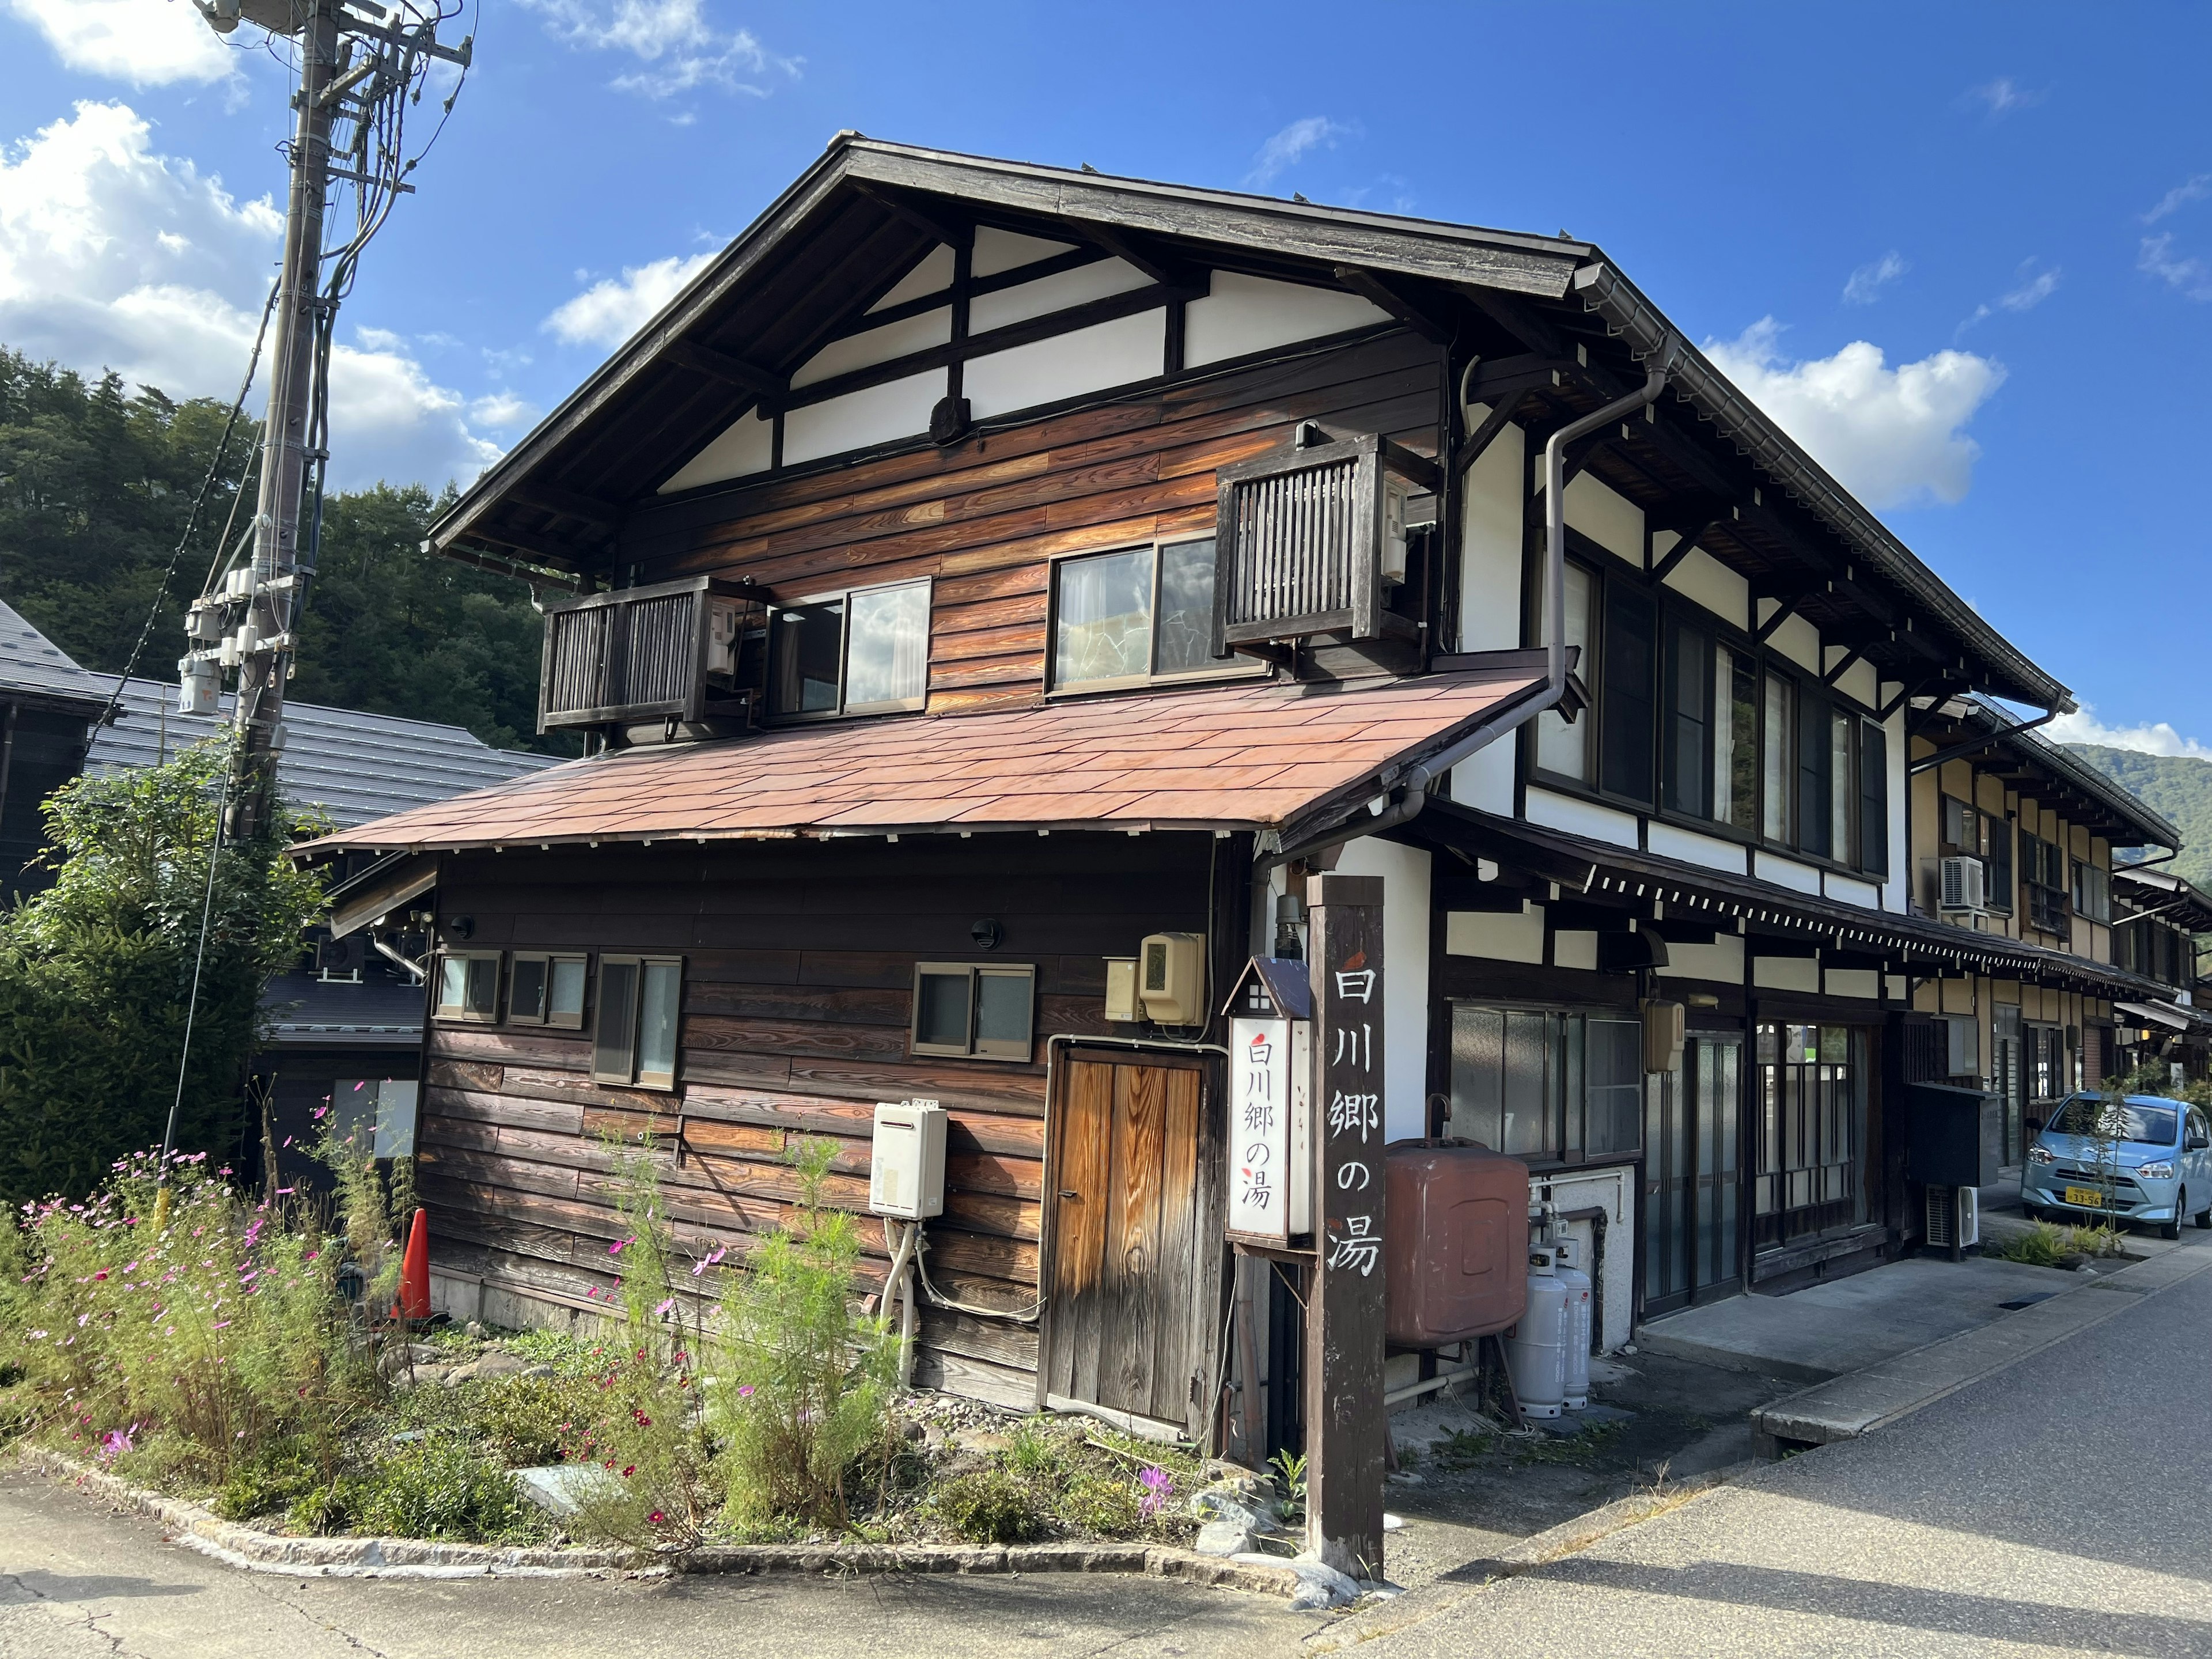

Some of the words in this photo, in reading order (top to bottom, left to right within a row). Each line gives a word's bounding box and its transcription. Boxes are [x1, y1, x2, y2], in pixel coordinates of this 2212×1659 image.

[1242, 1034, 1274, 1210] 白川郷の湯
[1327, 952, 1382, 1277] 白川郷の湯
